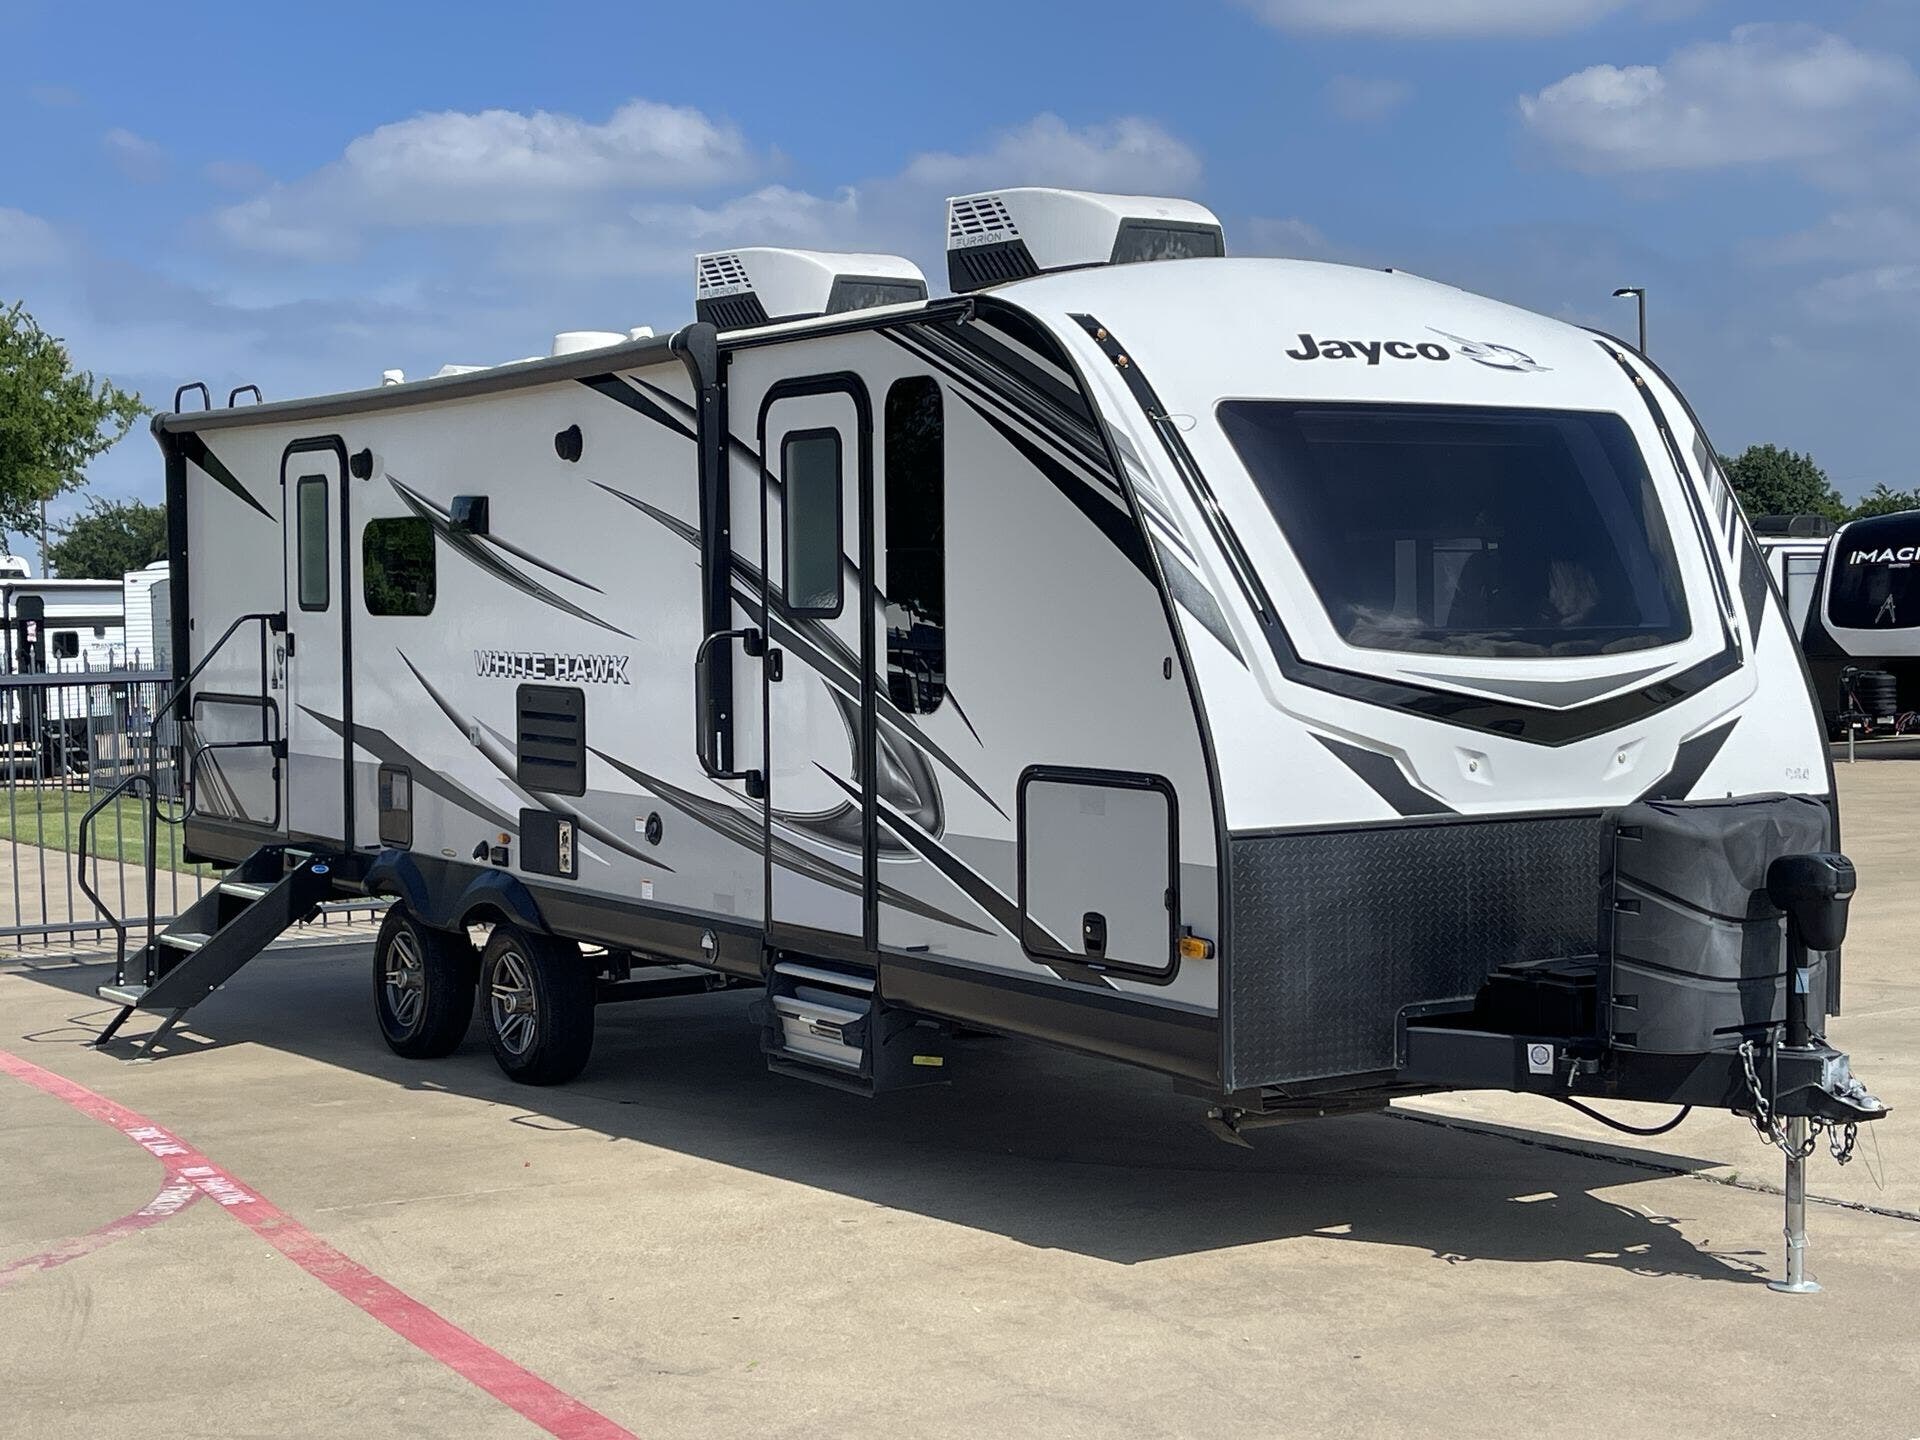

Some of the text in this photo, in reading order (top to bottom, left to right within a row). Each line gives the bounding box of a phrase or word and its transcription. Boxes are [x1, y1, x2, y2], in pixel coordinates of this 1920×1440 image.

[956, 232, 1002, 248] FURRION
[1285, 333, 1451, 365] Jayco
[474, 650, 630, 685] WHITE HAWK
